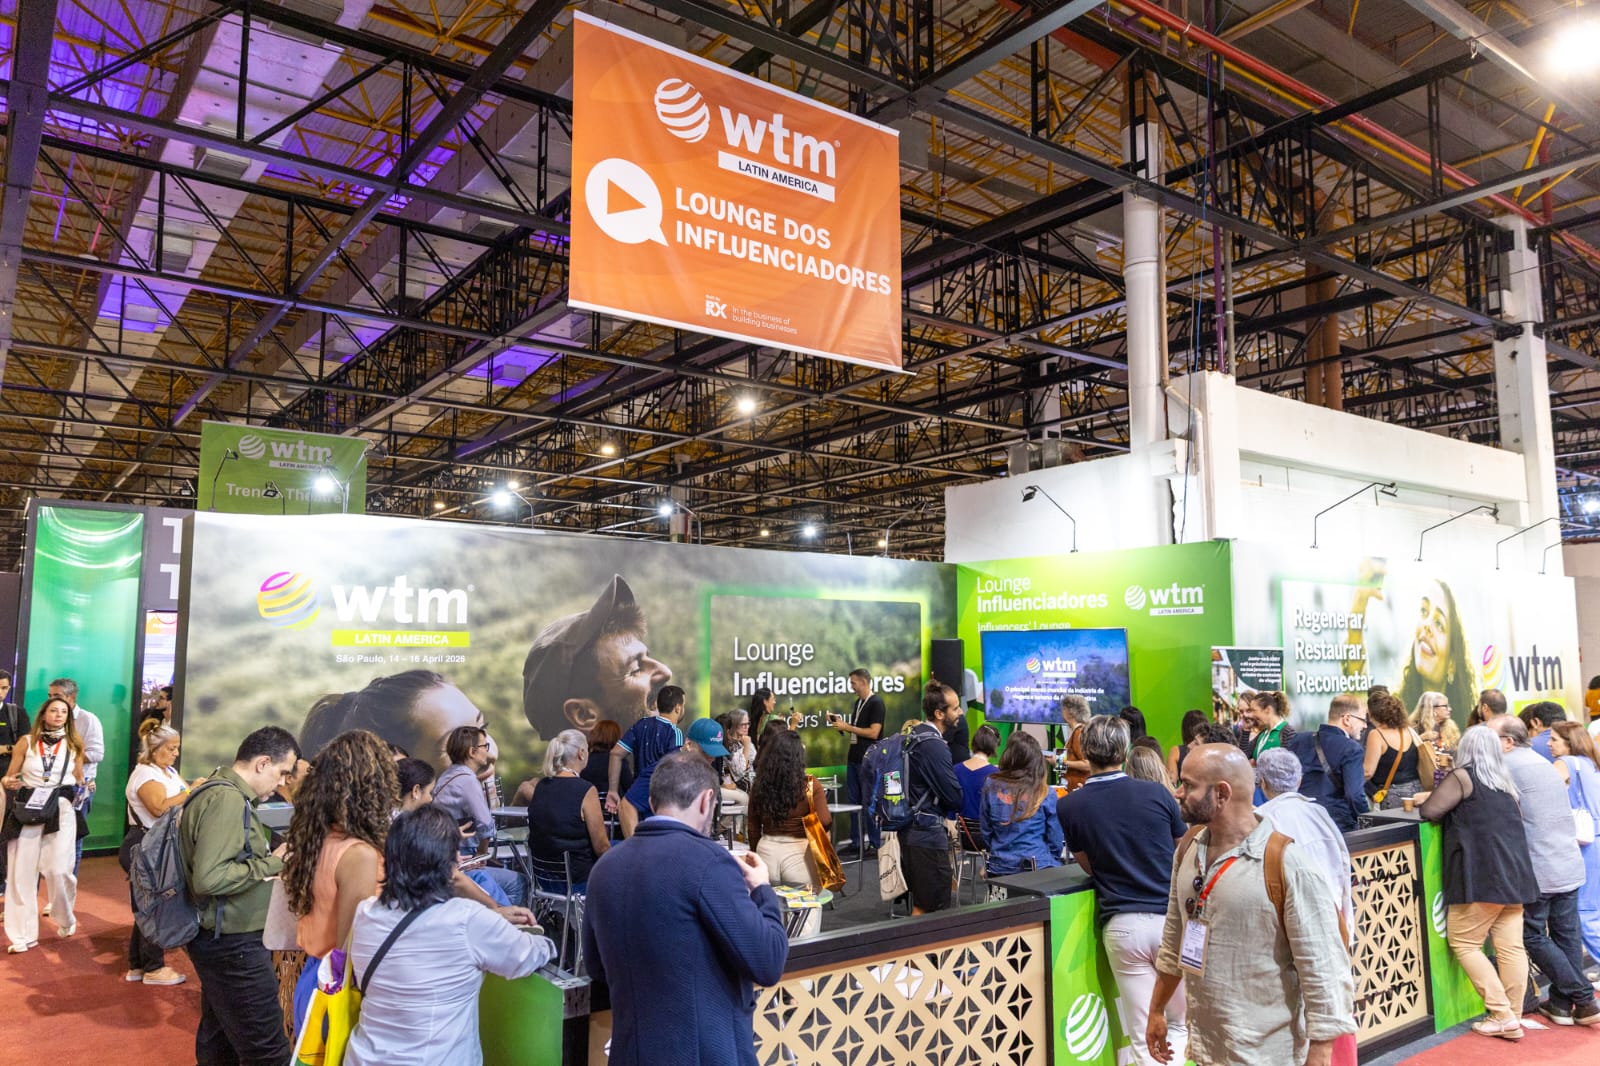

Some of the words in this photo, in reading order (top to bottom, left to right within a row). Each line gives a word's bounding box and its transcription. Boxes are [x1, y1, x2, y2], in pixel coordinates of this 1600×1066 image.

[738, 160, 769, 179] LATIN
[771, 171, 819, 194] AMERICA
[675, 187, 776, 236] LOUNGE
[783, 218, 831, 250] DOS
[675, 220, 892, 296] INFLUENCIADORES
[705, 300, 728, 320] RX
[732, 306, 739, 314] In
[740, 307, 752, 318] the
[753, 310, 782, 324] business
[732, 315, 761, 328] building
[761, 320, 798, 335] businesses
[977, 576, 1031, 595] Lounge
[977, 591, 1108, 613] Influenciadores
[1295, 606, 1368, 634] Regenerar.
[354, 633, 391, 645] LATIN
[394, 634, 449, 645] AMERICA
[1295, 638, 1367, 660] Restaurar.
[335, 653, 355, 663] São
[357, 654, 386, 664] Paulo,
[389, 655, 399, 663] 14
[422, 654, 443, 665] April
[733, 636, 815, 666] Lounge
[1509, 644, 1563, 692] wtm
[733, 671, 905, 697] Influenciares
